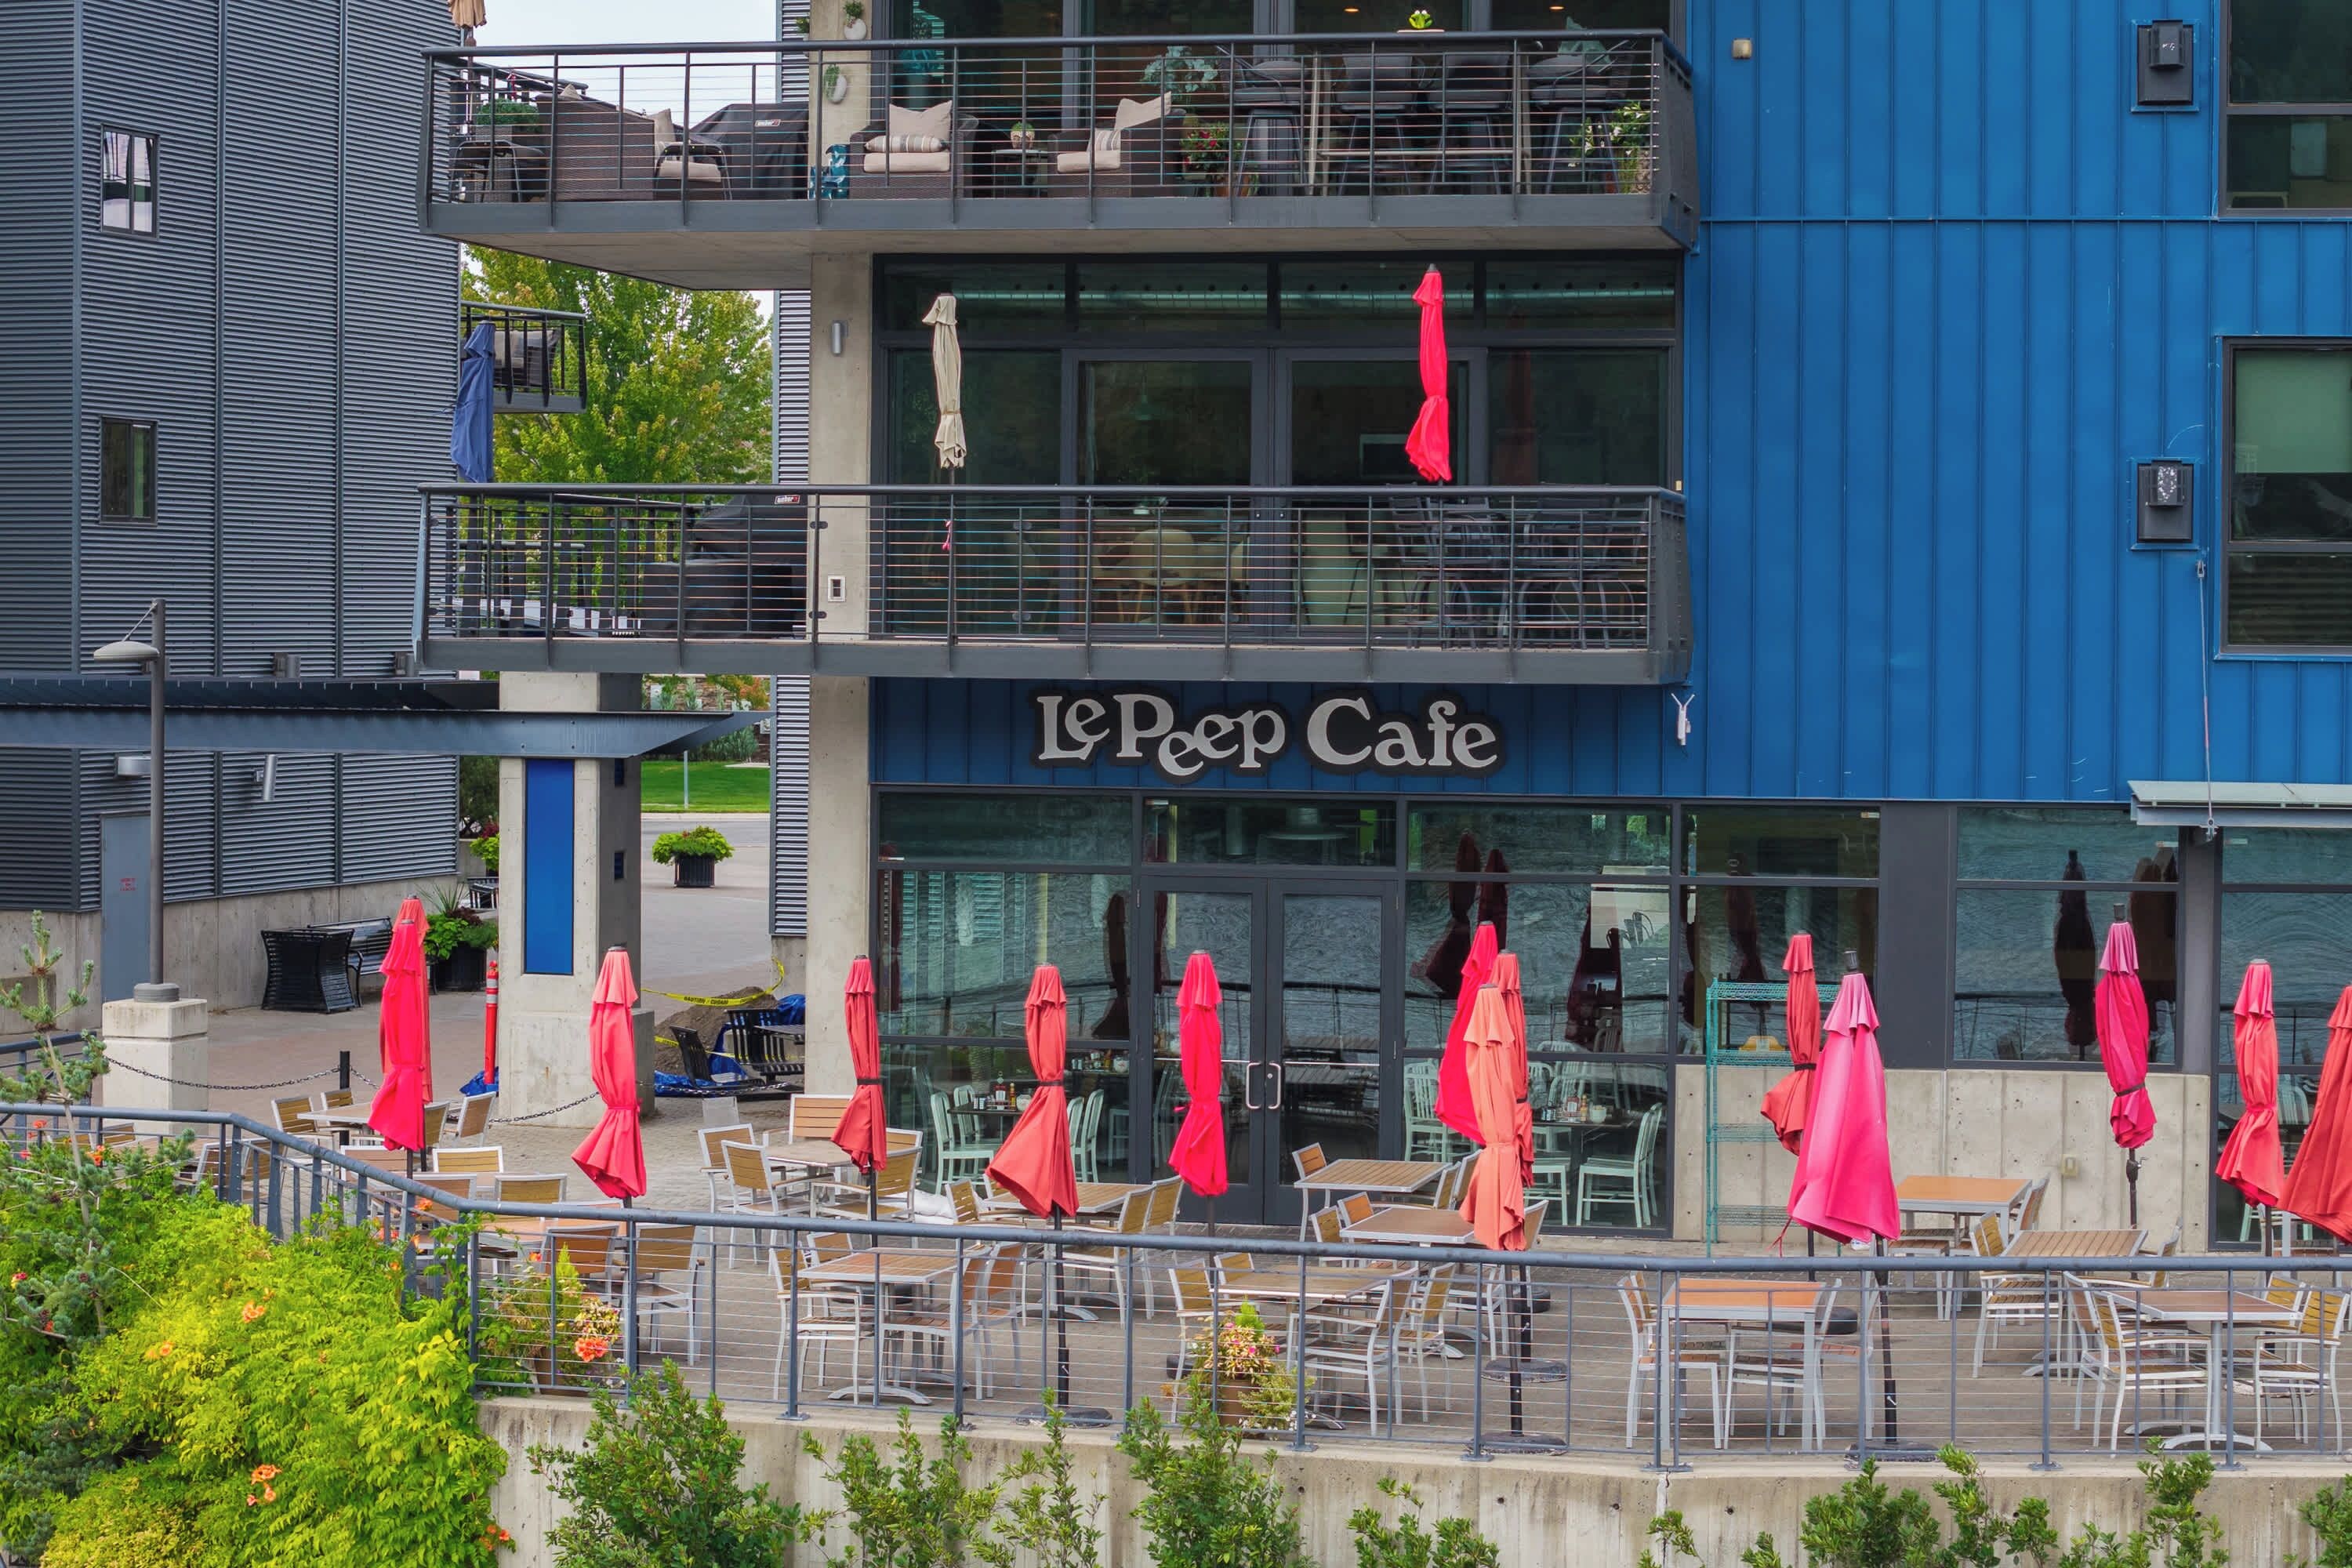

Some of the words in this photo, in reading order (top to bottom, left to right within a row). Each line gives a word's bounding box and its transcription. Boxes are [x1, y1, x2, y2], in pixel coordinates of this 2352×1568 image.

[1036, 695, 1110, 760] Le
[1112, 693, 1286, 777] Peep
[1306, 696, 1497, 768] Cafe
